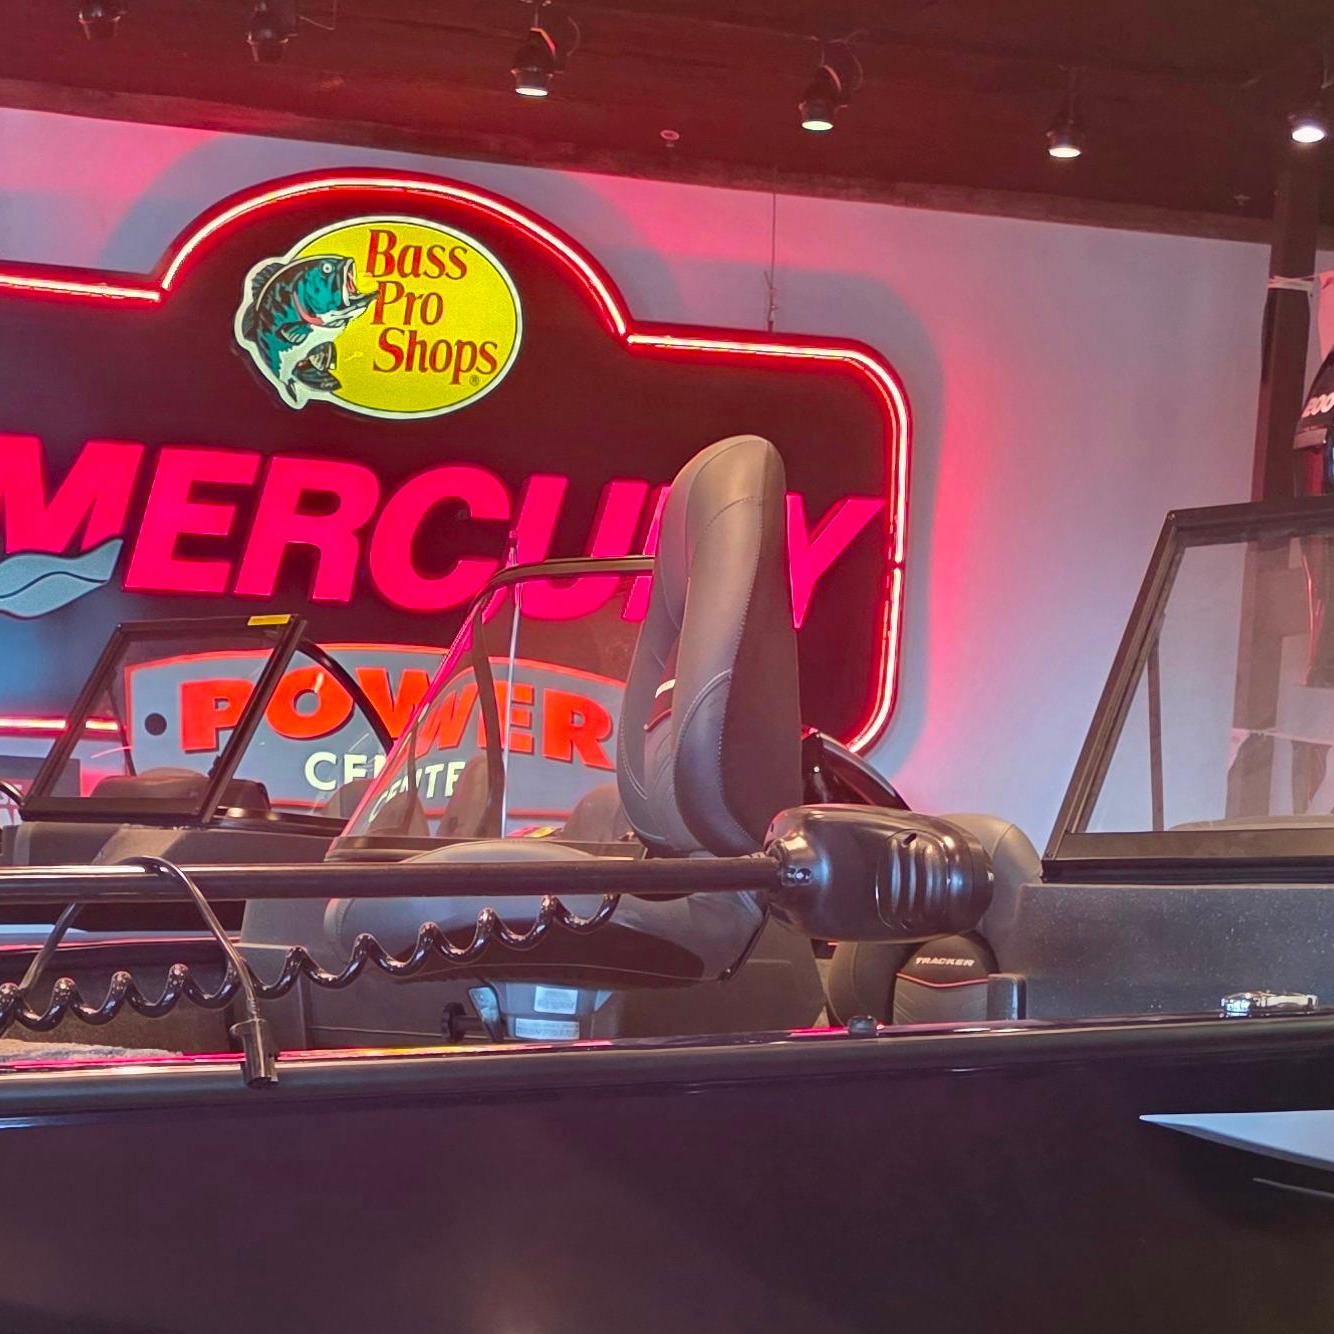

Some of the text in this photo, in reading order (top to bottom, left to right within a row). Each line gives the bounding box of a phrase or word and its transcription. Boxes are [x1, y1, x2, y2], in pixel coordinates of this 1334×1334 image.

[364, 229, 468, 280] Bass
[370, 280, 444, 326] Pro
[373, 326, 498, 386] Shops
[180, 665, 616, 770] POWER
[915, 957, 975, 967] TRACKER
